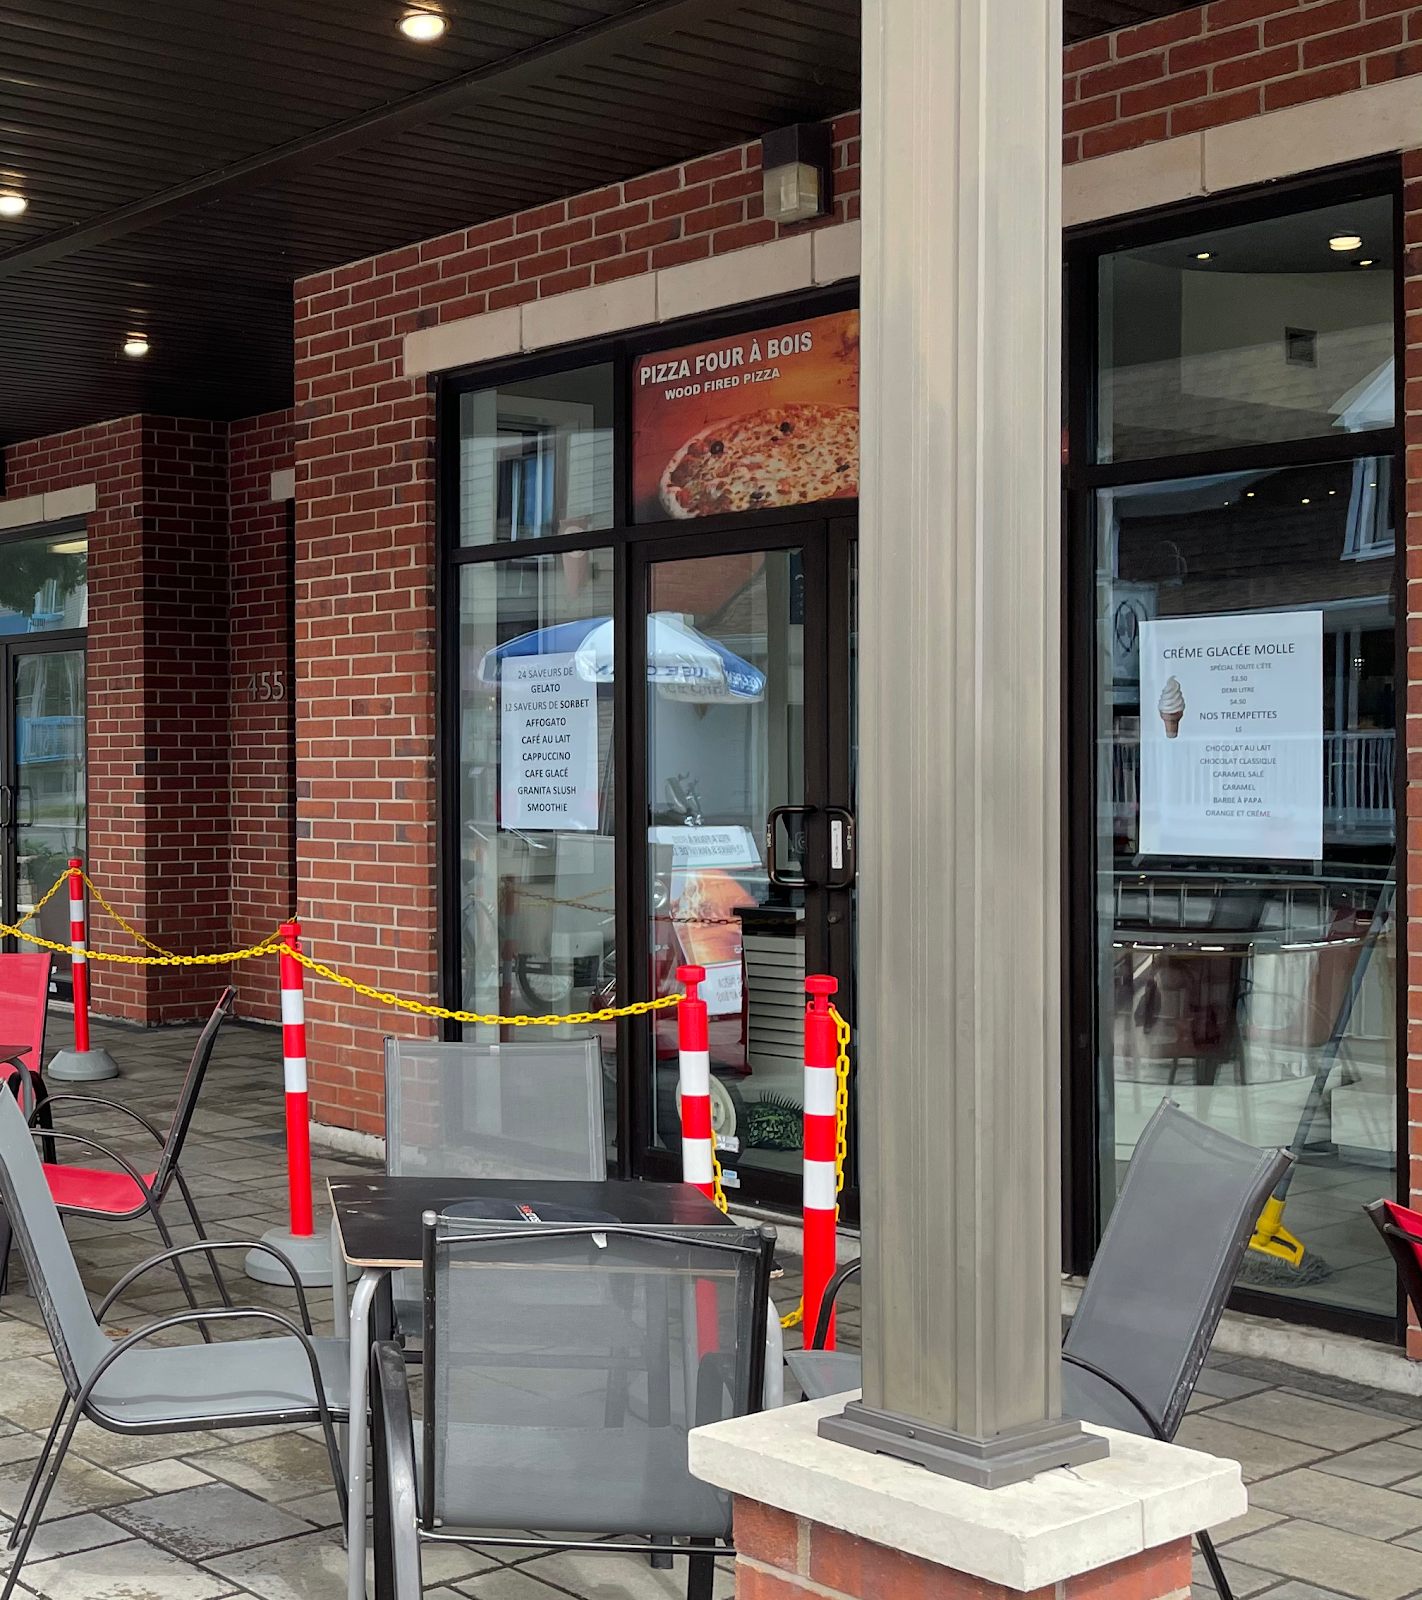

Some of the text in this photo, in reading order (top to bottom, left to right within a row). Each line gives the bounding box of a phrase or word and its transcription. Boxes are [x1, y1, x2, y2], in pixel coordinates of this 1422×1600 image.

[640, 331, 813, 386] PIZZA FOUR À BOIS
[665, 367, 781, 401] WOOD FIRED PIZZA
[1206, 643, 1251, 657] GLACÉE
[1254, 643, 1295, 655] MOLLE
[518, 667, 574, 679] 24 SAVEURS DE
[247, 671, 285, 701] 455
[530, 683, 561, 694] GELATO
[505, 698, 590, 712] 12 SAVEURS DE SORBET
[1199, 710, 1277, 720] NOS TREMPETTES
[525, 717, 567, 728] AFFOGATO
[521, 733, 571, 744] CAFÉ AU LAIT
[1205, 744, 1243, 752] CHOCOLAT
[522, 751, 571, 761] CAPPUCCINO
[1239, 757, 1277, 765] CLASSIQUE
[525, 767, 569, 778] CAFE GLACÉ
[1247, 769, 1264, 778] SALÉ
[517, 786, 577, 795] GRANITA SLUSH
[1222, 783, 1256, 791] CARAMEL
[527, 803, 568, 812] SMOOTHIE
